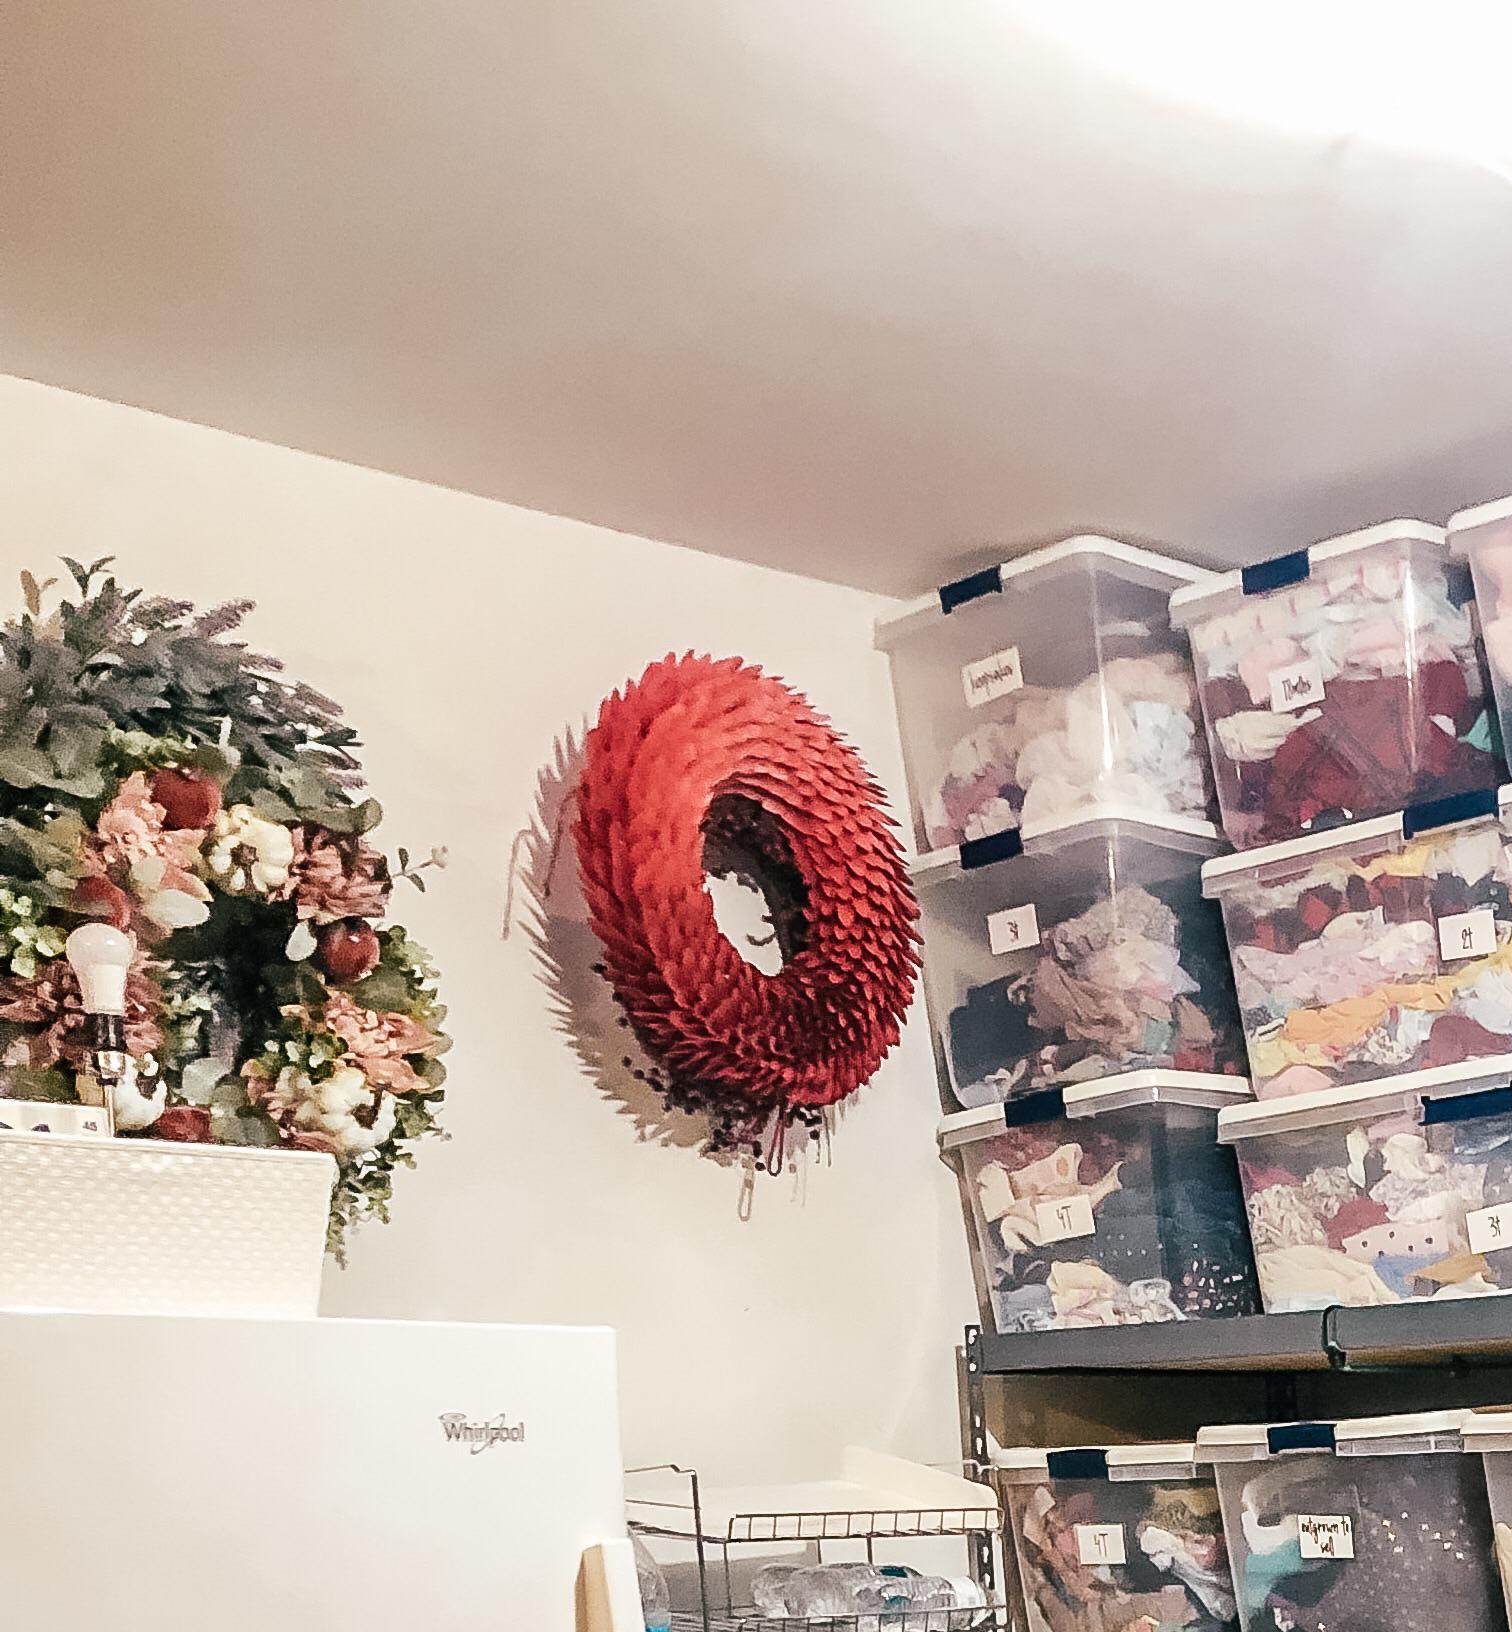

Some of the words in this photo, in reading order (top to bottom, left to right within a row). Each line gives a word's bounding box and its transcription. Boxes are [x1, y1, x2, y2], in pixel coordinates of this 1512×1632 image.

[1487, 1215, 1501, 1238] 3t
[442, 1421, 524, 1447] Whirlpool
[1320, 1535, 1335, 1557] sell
